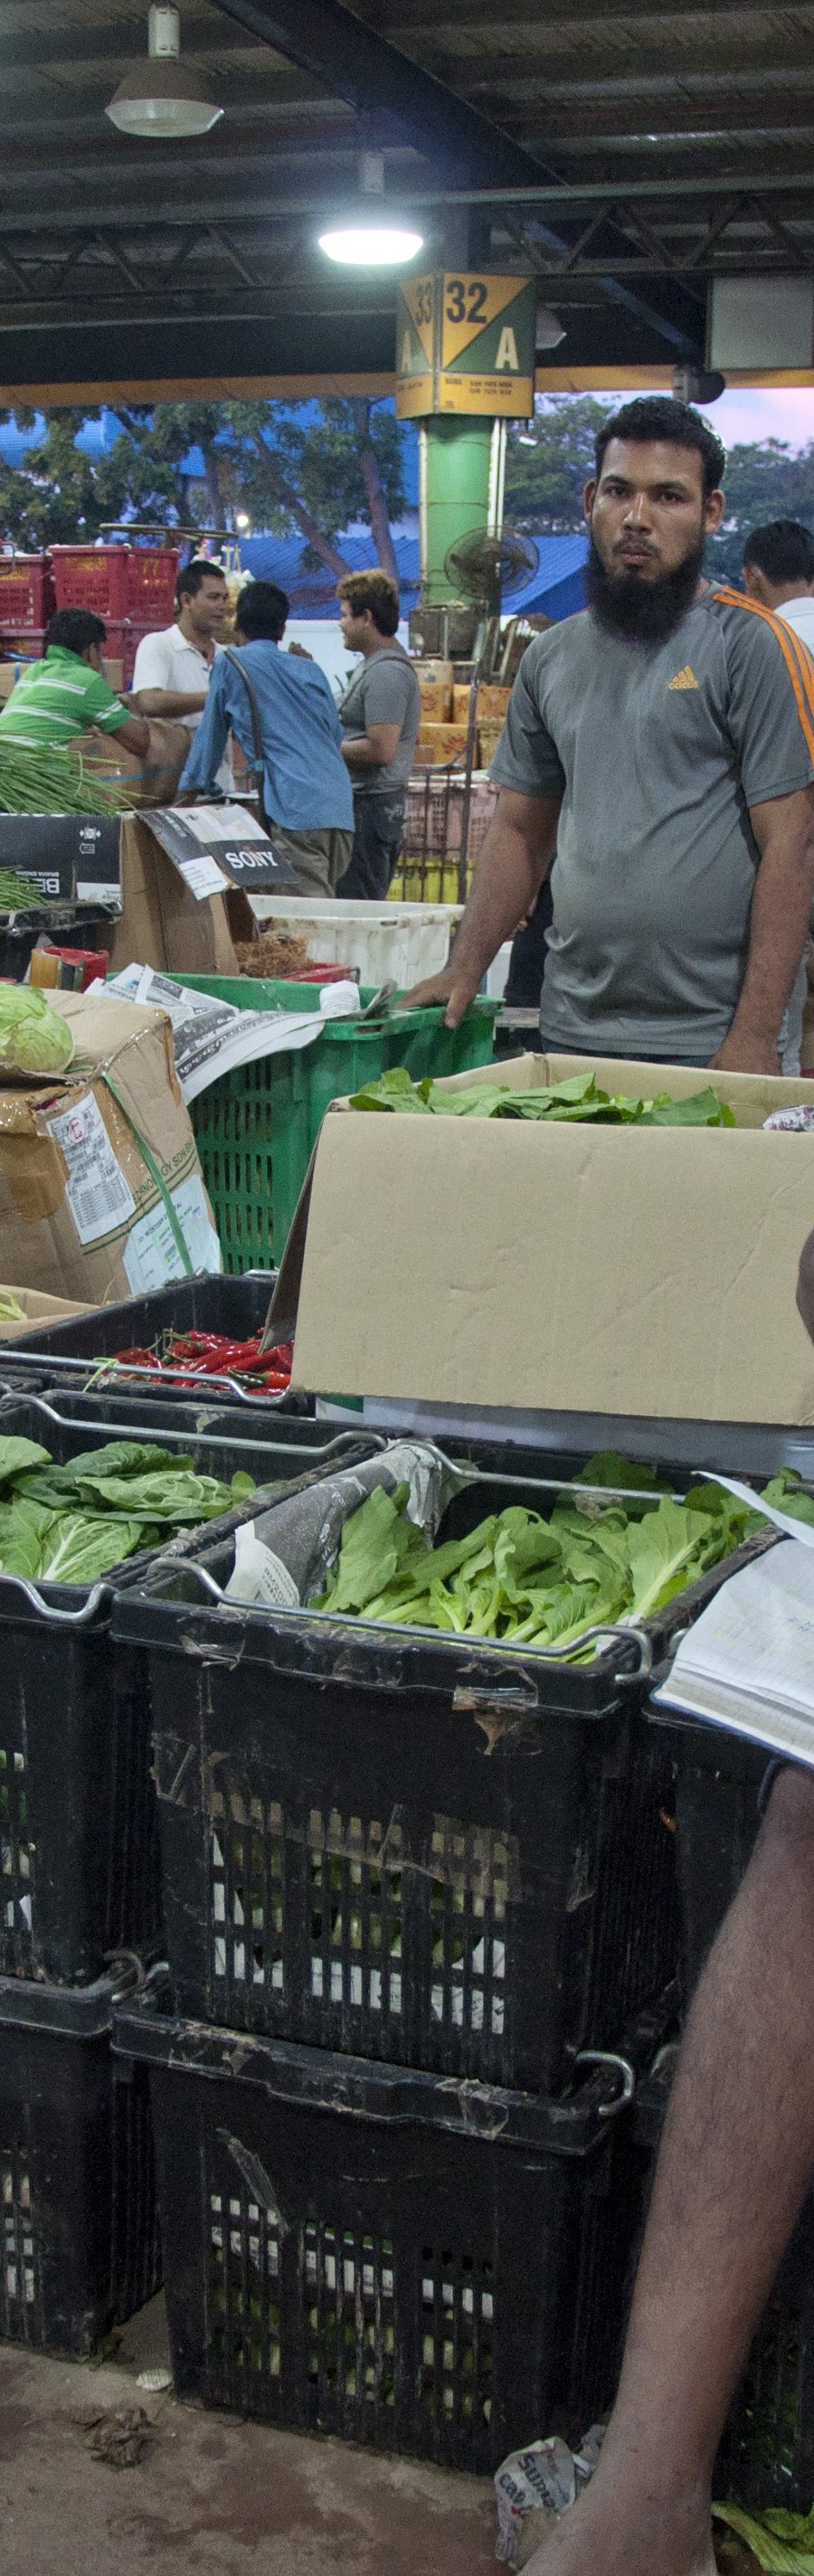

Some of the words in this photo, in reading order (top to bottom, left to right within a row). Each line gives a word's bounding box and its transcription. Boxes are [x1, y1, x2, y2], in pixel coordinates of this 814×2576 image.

[447, 279, 488, 323] 32
[401, 331, 412, 373] A
[495, 327, 520, 370] A
[669, 679, 698, 690] adidas
[225, 851, 278, 869] SONY
